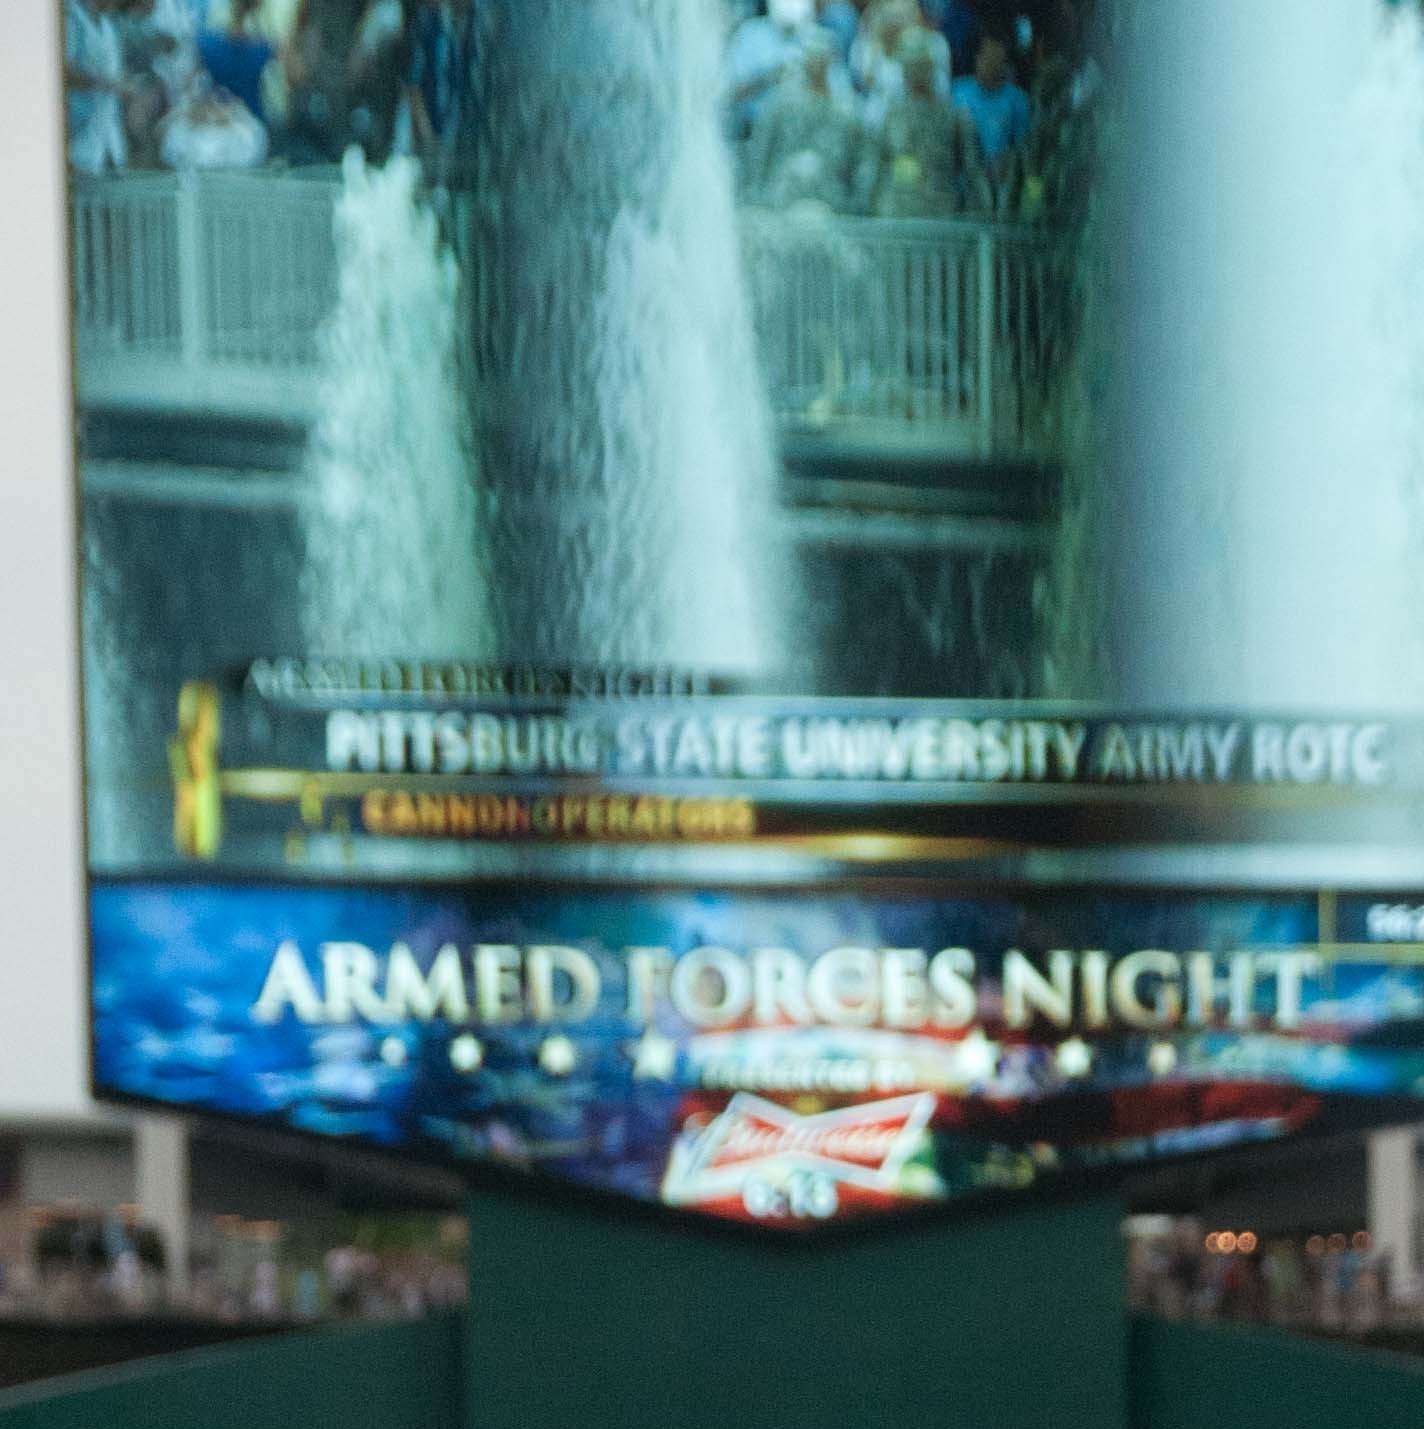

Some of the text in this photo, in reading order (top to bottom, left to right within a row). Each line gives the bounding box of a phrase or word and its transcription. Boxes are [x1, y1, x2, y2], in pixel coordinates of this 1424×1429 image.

[615, 712, 769, 777] STATE
[782, 713, 1085, 781] UNIVERSITY
[251, 941, 1320, 1029] ARMED FORCES NIGHT
